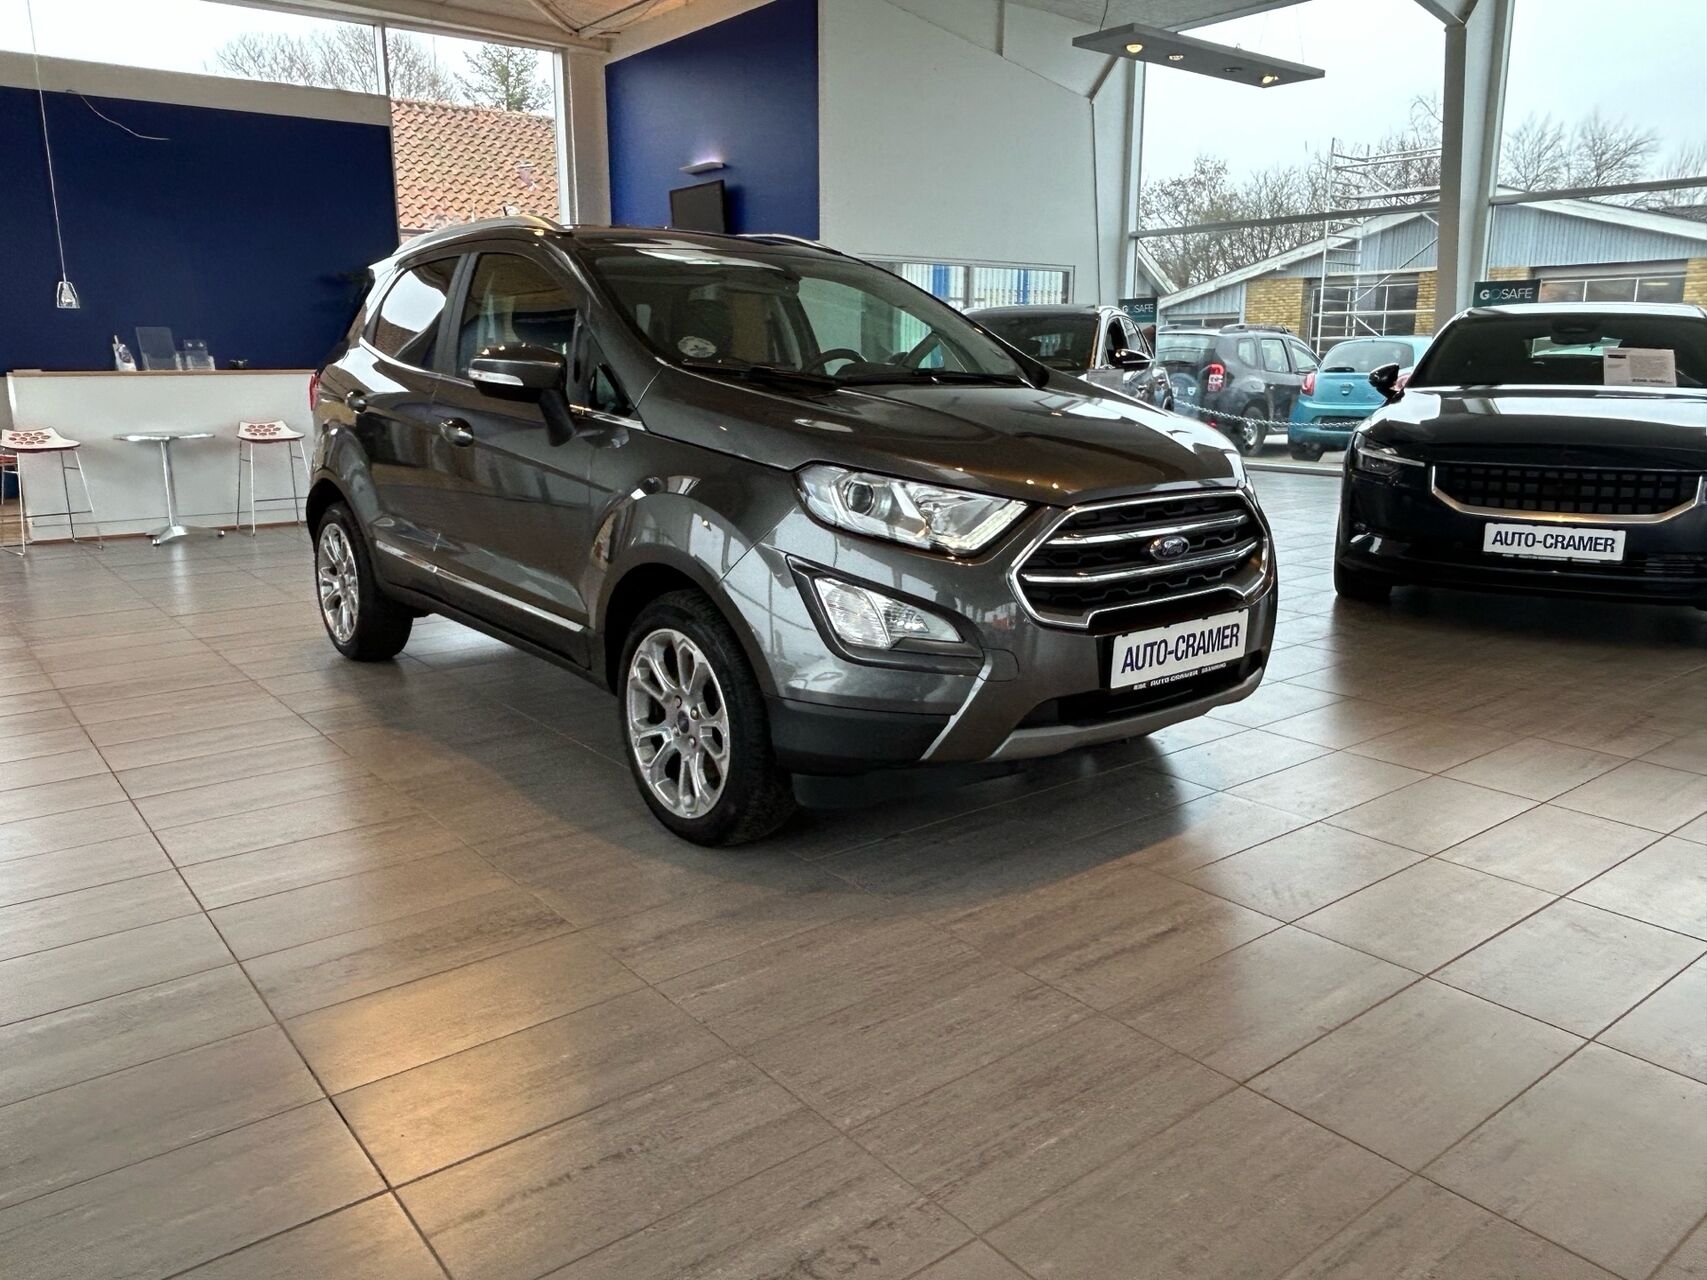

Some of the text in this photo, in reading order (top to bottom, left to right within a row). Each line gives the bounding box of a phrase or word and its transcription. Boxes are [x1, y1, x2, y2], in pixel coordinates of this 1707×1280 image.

[1122, 303, 1154, 313] GSAFE
[1491, 530, 1616, 553] AUTO-CRAMER
[1120, 622, 1240, 674] AUTO-CRAMER
